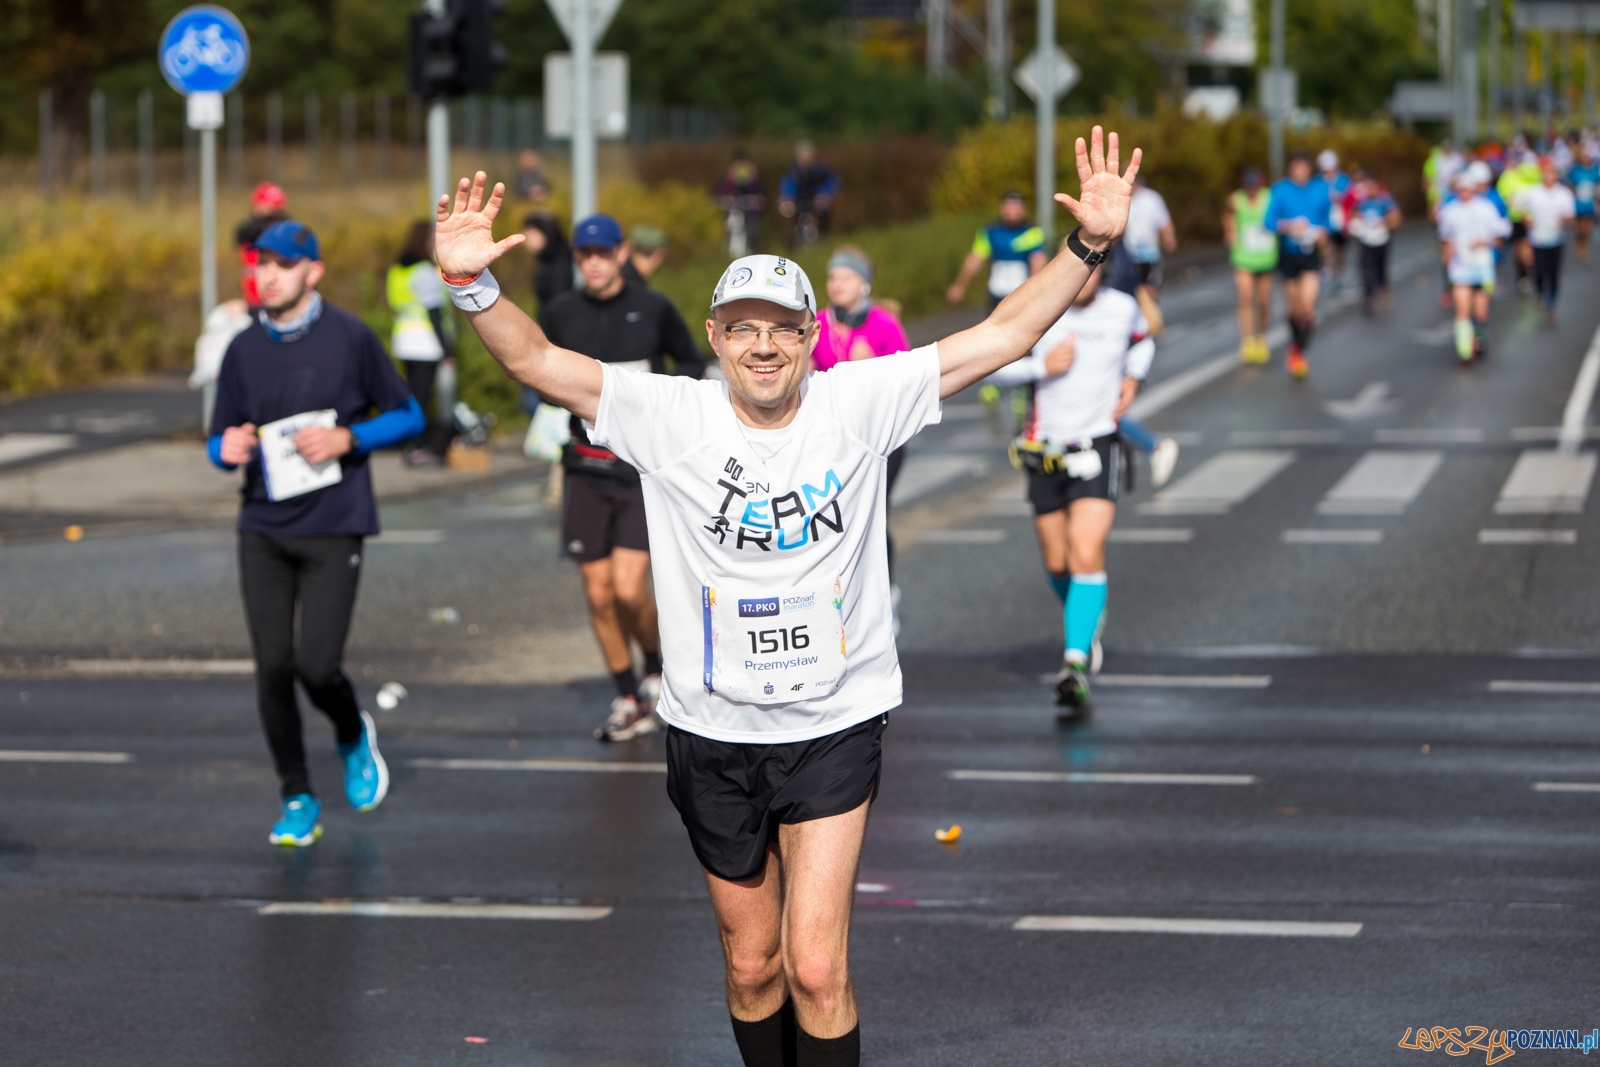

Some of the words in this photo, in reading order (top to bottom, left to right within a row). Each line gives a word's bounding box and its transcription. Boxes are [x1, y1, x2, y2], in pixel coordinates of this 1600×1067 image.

[716, 468, 842, 530] TEAM
[736, 499, 844, 552] RUN
[784, 600, 815, 611] maraton
[747, 625, 810, 654] 1516
[744, 655, 819, 671] Przemysław
[790, 683, 804, 691] 4F
